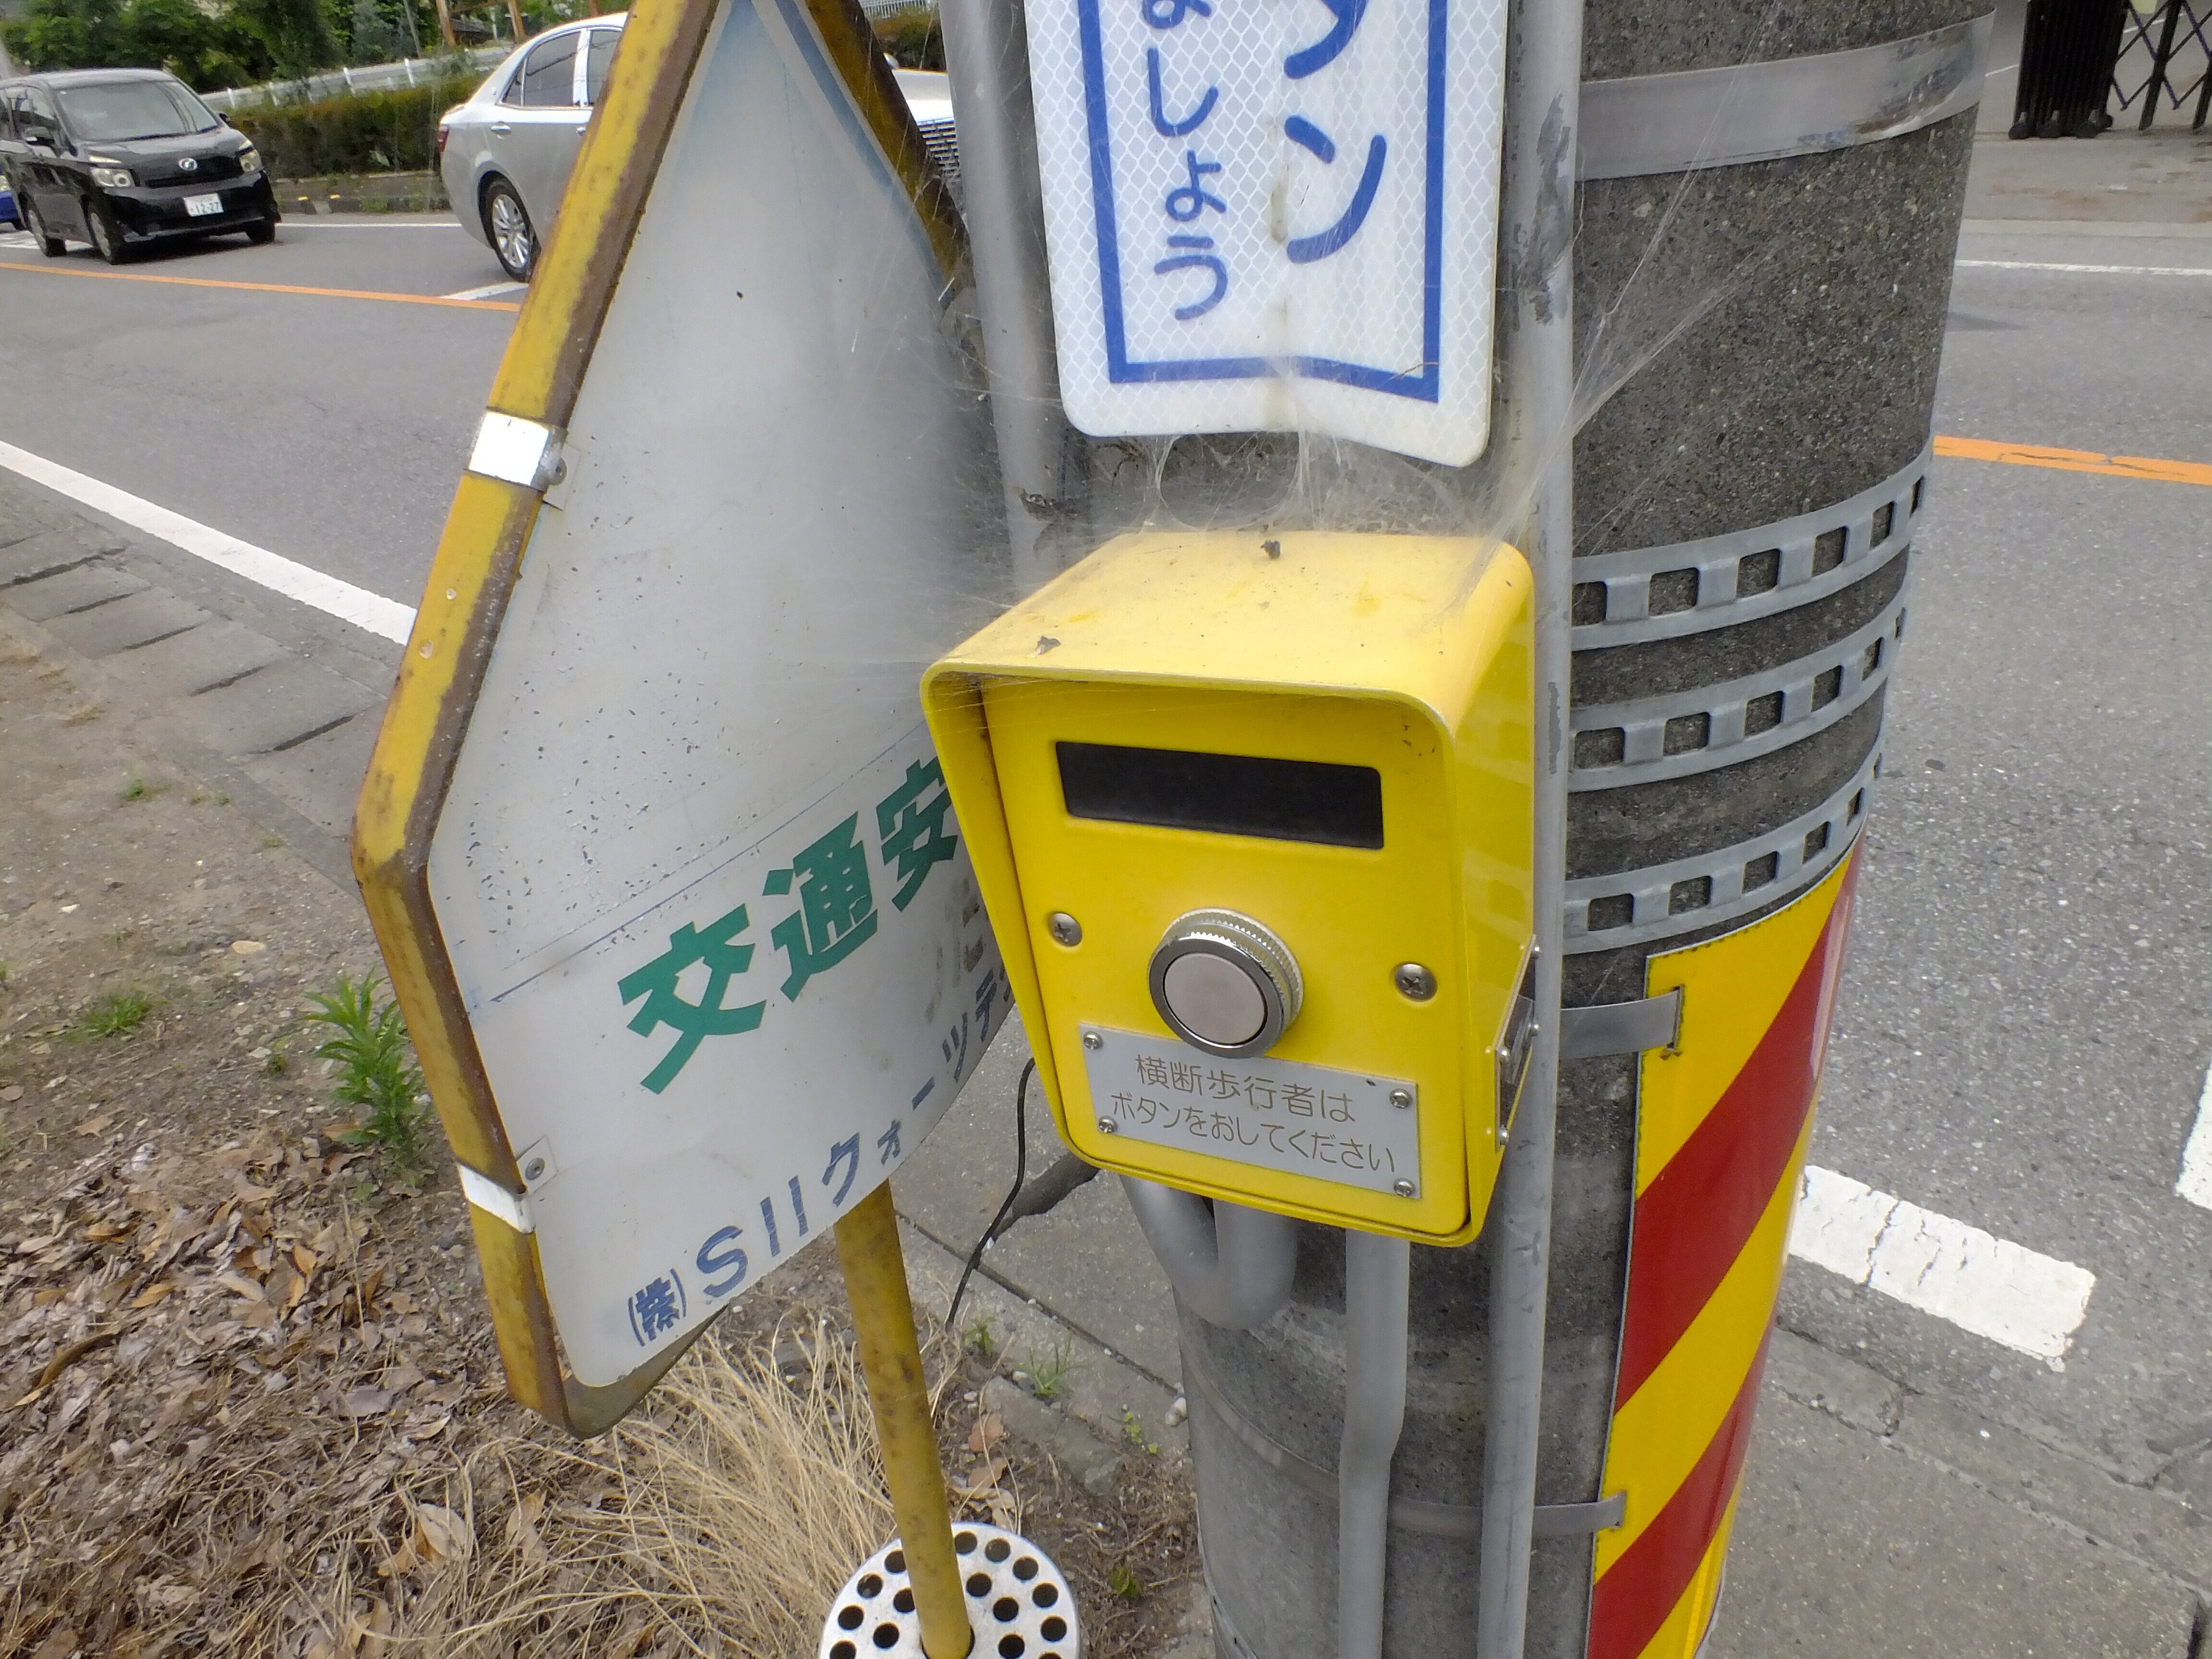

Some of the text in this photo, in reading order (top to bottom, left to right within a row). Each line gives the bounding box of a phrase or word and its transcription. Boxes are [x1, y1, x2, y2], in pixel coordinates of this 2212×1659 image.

[1136, 1054, 1355, 1123] 横断歩行者は
[1110, 1094, 1395, 1172] ボタンをおしてください
